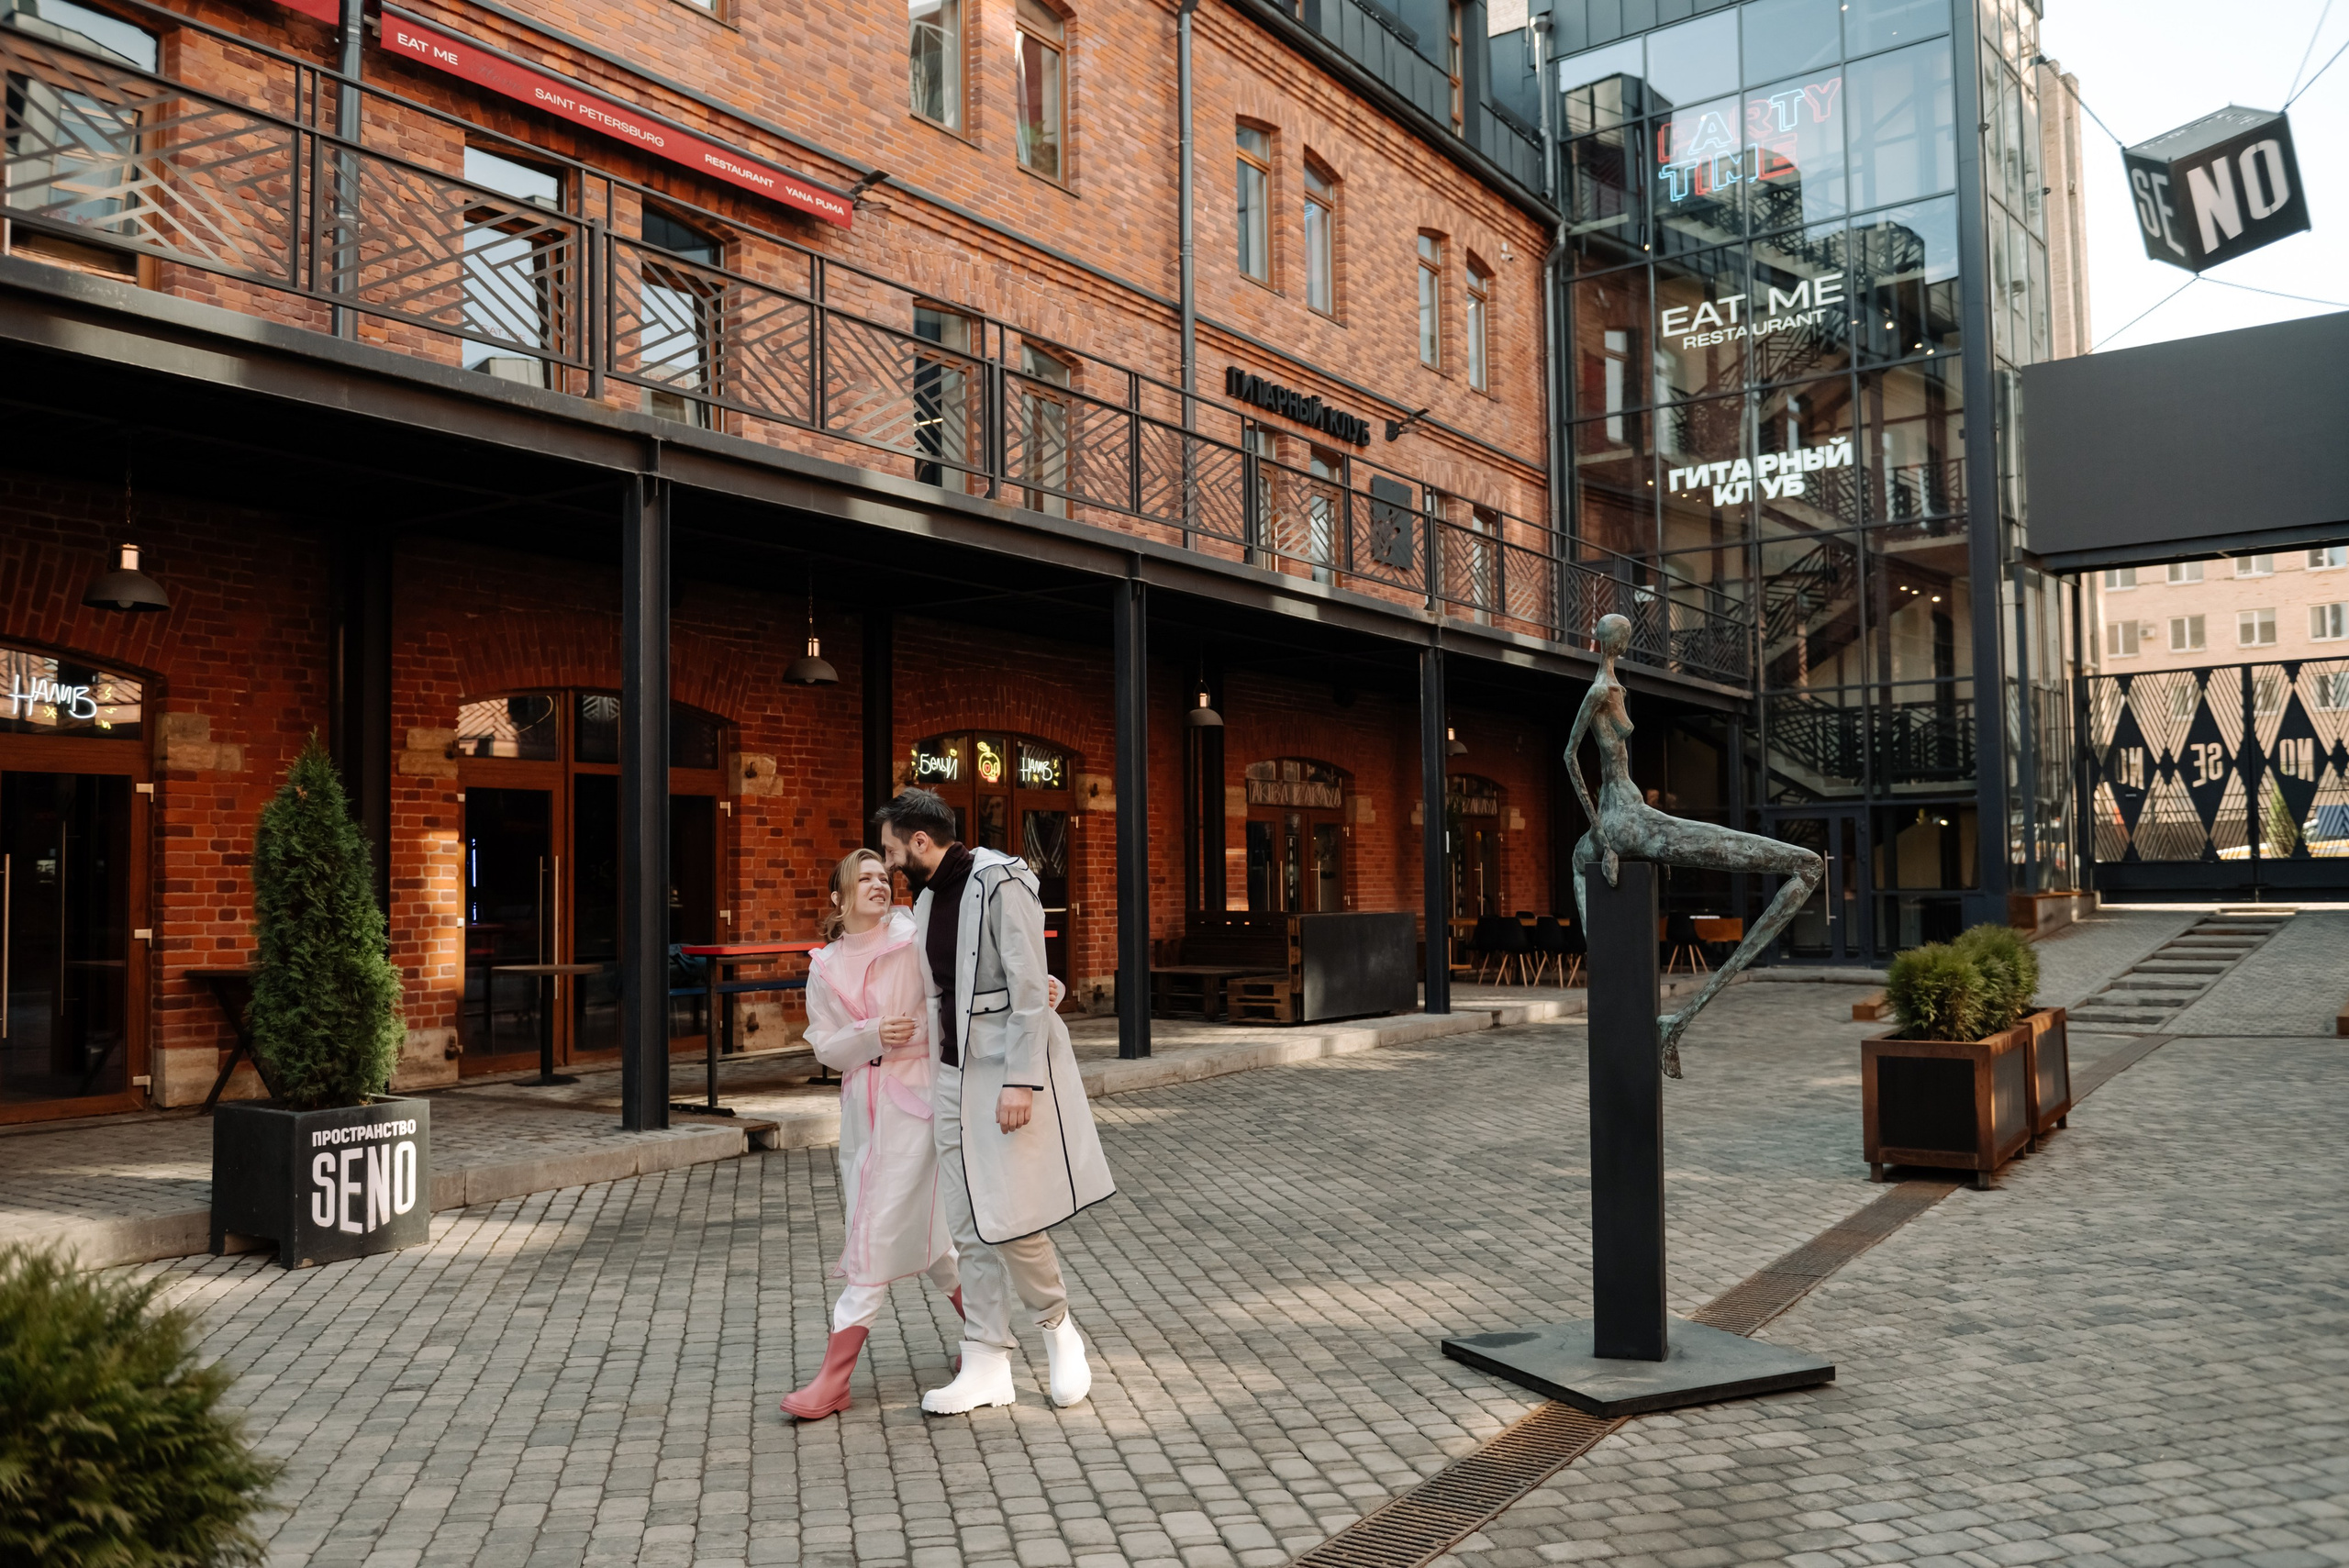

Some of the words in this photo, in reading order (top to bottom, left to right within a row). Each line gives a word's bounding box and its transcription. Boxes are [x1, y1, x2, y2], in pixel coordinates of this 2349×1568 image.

[397, 32, 429, 53] EAT
[434, 47, 459, 65] ME
[535, 88, 575, 110] SAINT
[580, 105, 664, 147] PETERSBURG
[705, 153, 774, 187] RESTAURANT
[785, 186, 813, 204] YANA
[816, 197, 844, 216] PUMA
[1657, 77, 1842, 162] PARTY
[1658, 133, 1798, 203] TIME
[2187, 139, 2290, 254] NO
[1662, 294, 1746, 338] EAT
[1768, 272, 1844, 316] ME
[1683, 308, 1827, 350] RESTAURANT
[1226, 366, 1324, 431] ГИТАРНЫЙ
[1325, 406, 1371, 446] КЛУБ
[1668, 436, 1853, 492] ГИТАРНЫЙ
[1713, 473, 1805, 506] КЛУБ
[312, 1118, 417, 1147] ПРОСТРАНСТВО
[312, 1140, 417, 1234] SENO
